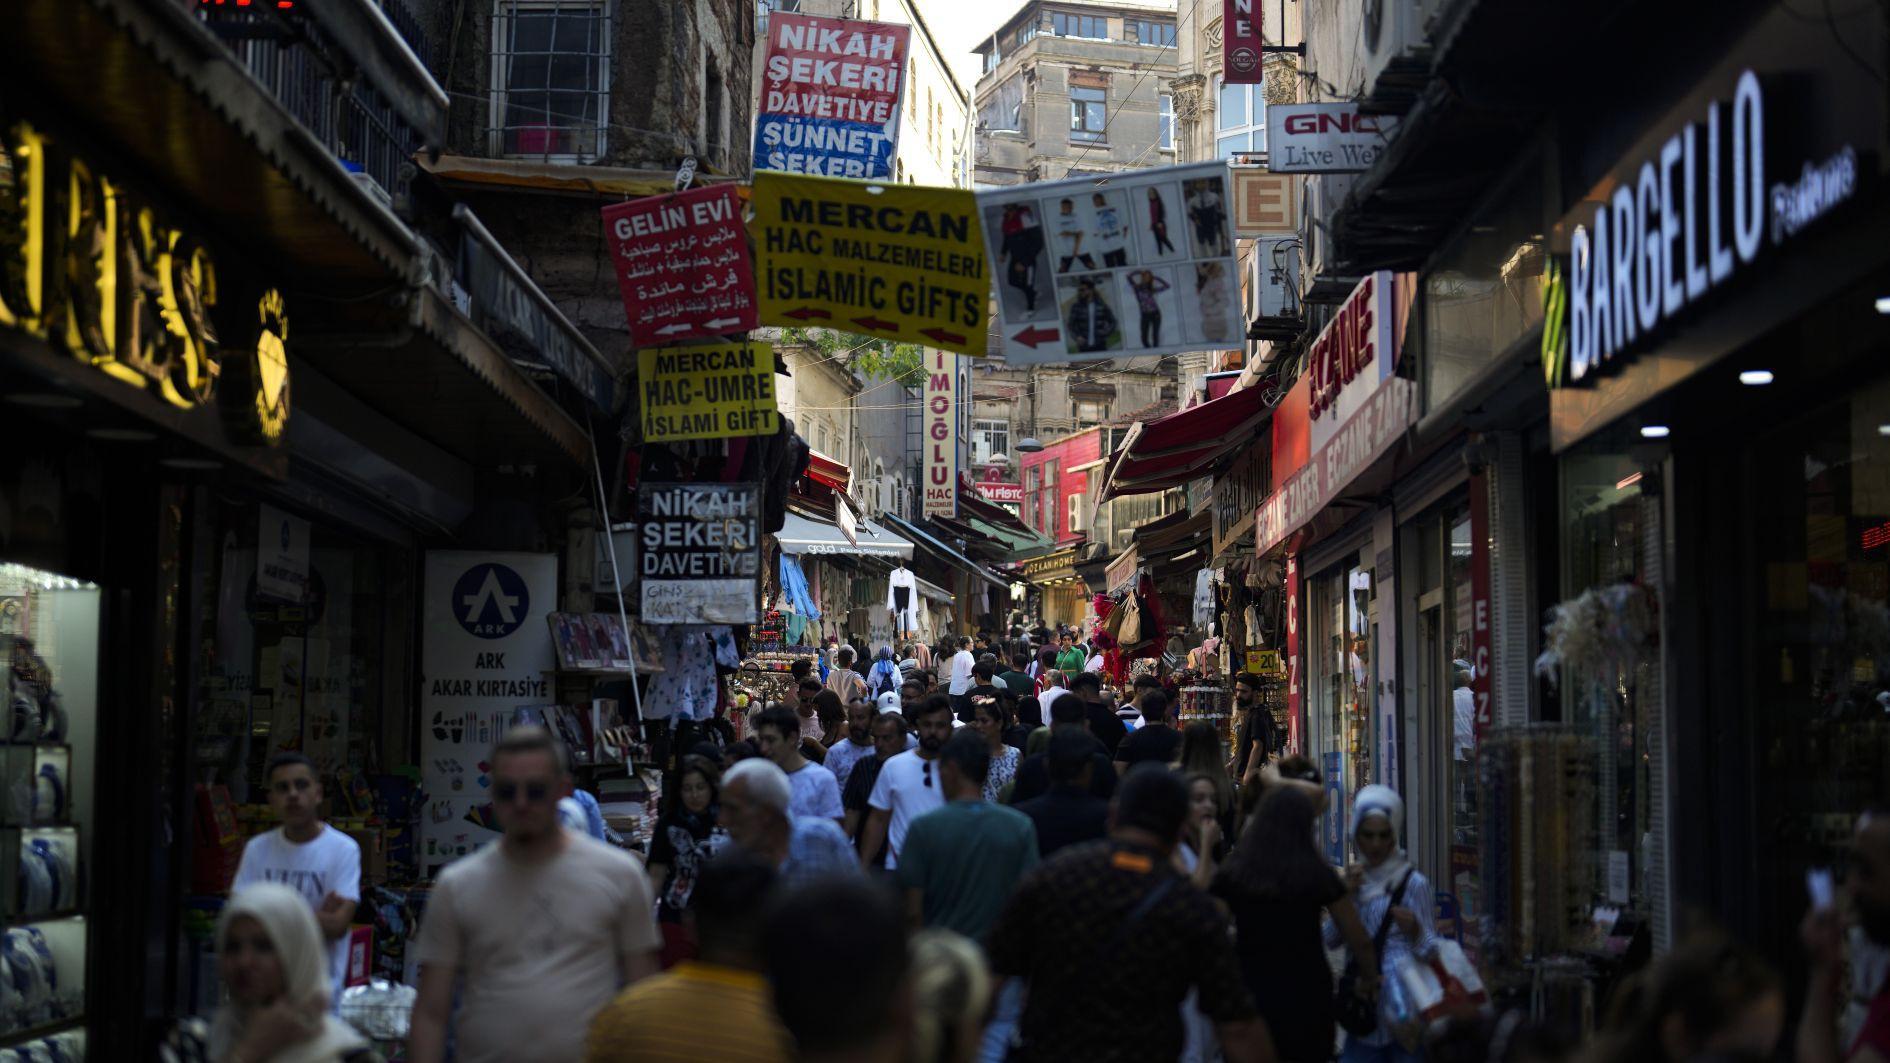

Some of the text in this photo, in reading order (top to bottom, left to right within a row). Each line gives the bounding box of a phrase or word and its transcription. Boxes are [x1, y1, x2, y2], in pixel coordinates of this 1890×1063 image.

[779, 20, 896, 60] NİKAH
[767, 55, 899, 93] ŞEKERİ
[766, 90, 889, 123] DAVETİYE
[763, 117, 884, 156] SÜNNET
[1284, 112, 1380, 136] GNC
[1285, 145, 1333, 167] Live
[614, 192, 733, 240] GELİN EVİ
[1246, 180, 1283, 223] E
[780, 196, 969, 243] MERCAN
[1569, 67, 1765, 383] BARGELLO
[765, 226, 983, 280] HAC MALZEMELERİ
[767, 260, 980, 328] İSLAMİC GİFTS
[657, 349, 755, 375] MERCAN
[645, 373, 771, 407] HAC-UMRE
[647, 405, 773, 437] İSLAMİ GİFT
[1326, 404, 1373, 492] ECZANE
[651, 488, 747, 517] NİKAH
[927, 488, 952, 500] HAC
[1257, 490, 1289, 550] ECZANE
[1289, 462, 1320, 524] ZAFER
[643, 519, 756, 552] ŞEKERİ
[807, 544, 836, 555] gold
[643, 551, 757, 576] DAVETİYE
[1054, 555, 1075, 569] HOME
[472, 623, 506, 635] ARK
[475, 652, 506, 669] ARK
[432, 676, 547, 698] AKAR KIRTASİYE
